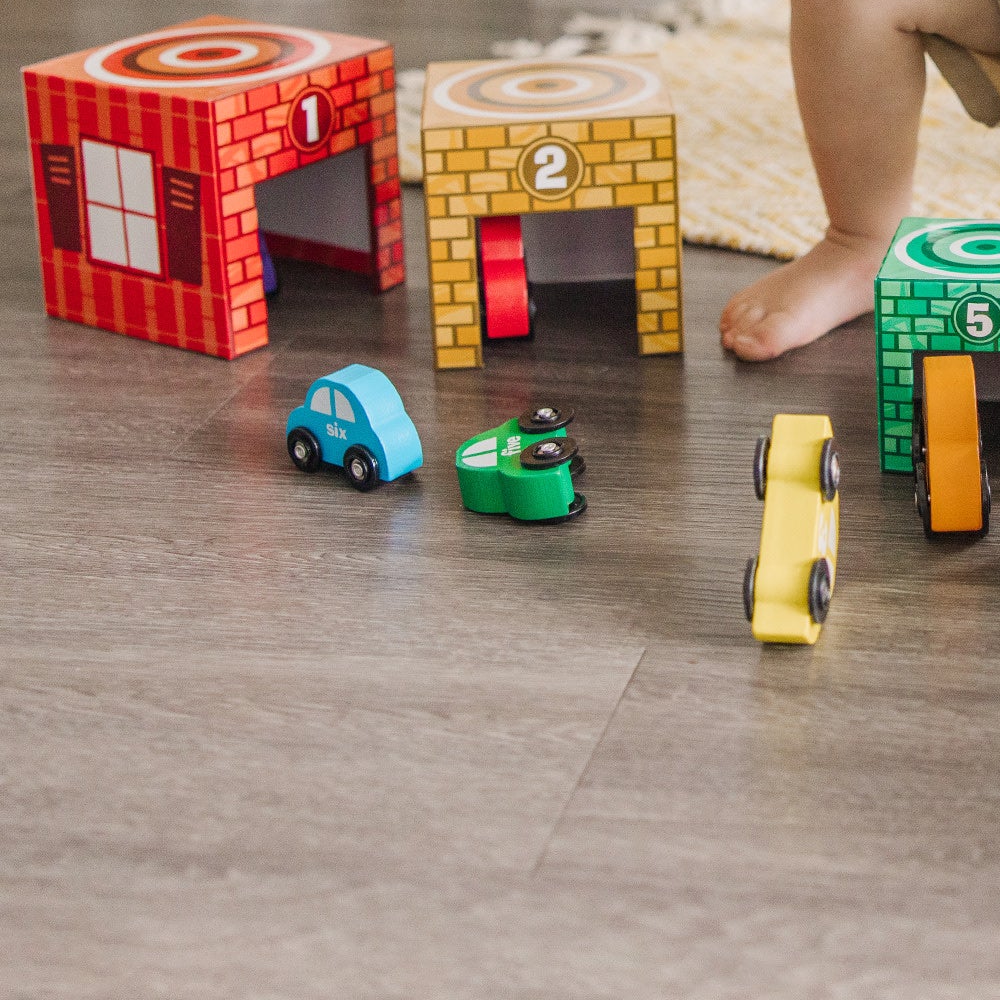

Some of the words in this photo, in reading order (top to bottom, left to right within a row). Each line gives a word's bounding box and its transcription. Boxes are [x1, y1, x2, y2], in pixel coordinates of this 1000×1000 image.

[301, 96, 319, 143] 1
[534, 145, 569, 190] 2
[965, 303, 993, 337] 5
[325, 421, 348, 440] six
[500, 434, 521, 458] five
